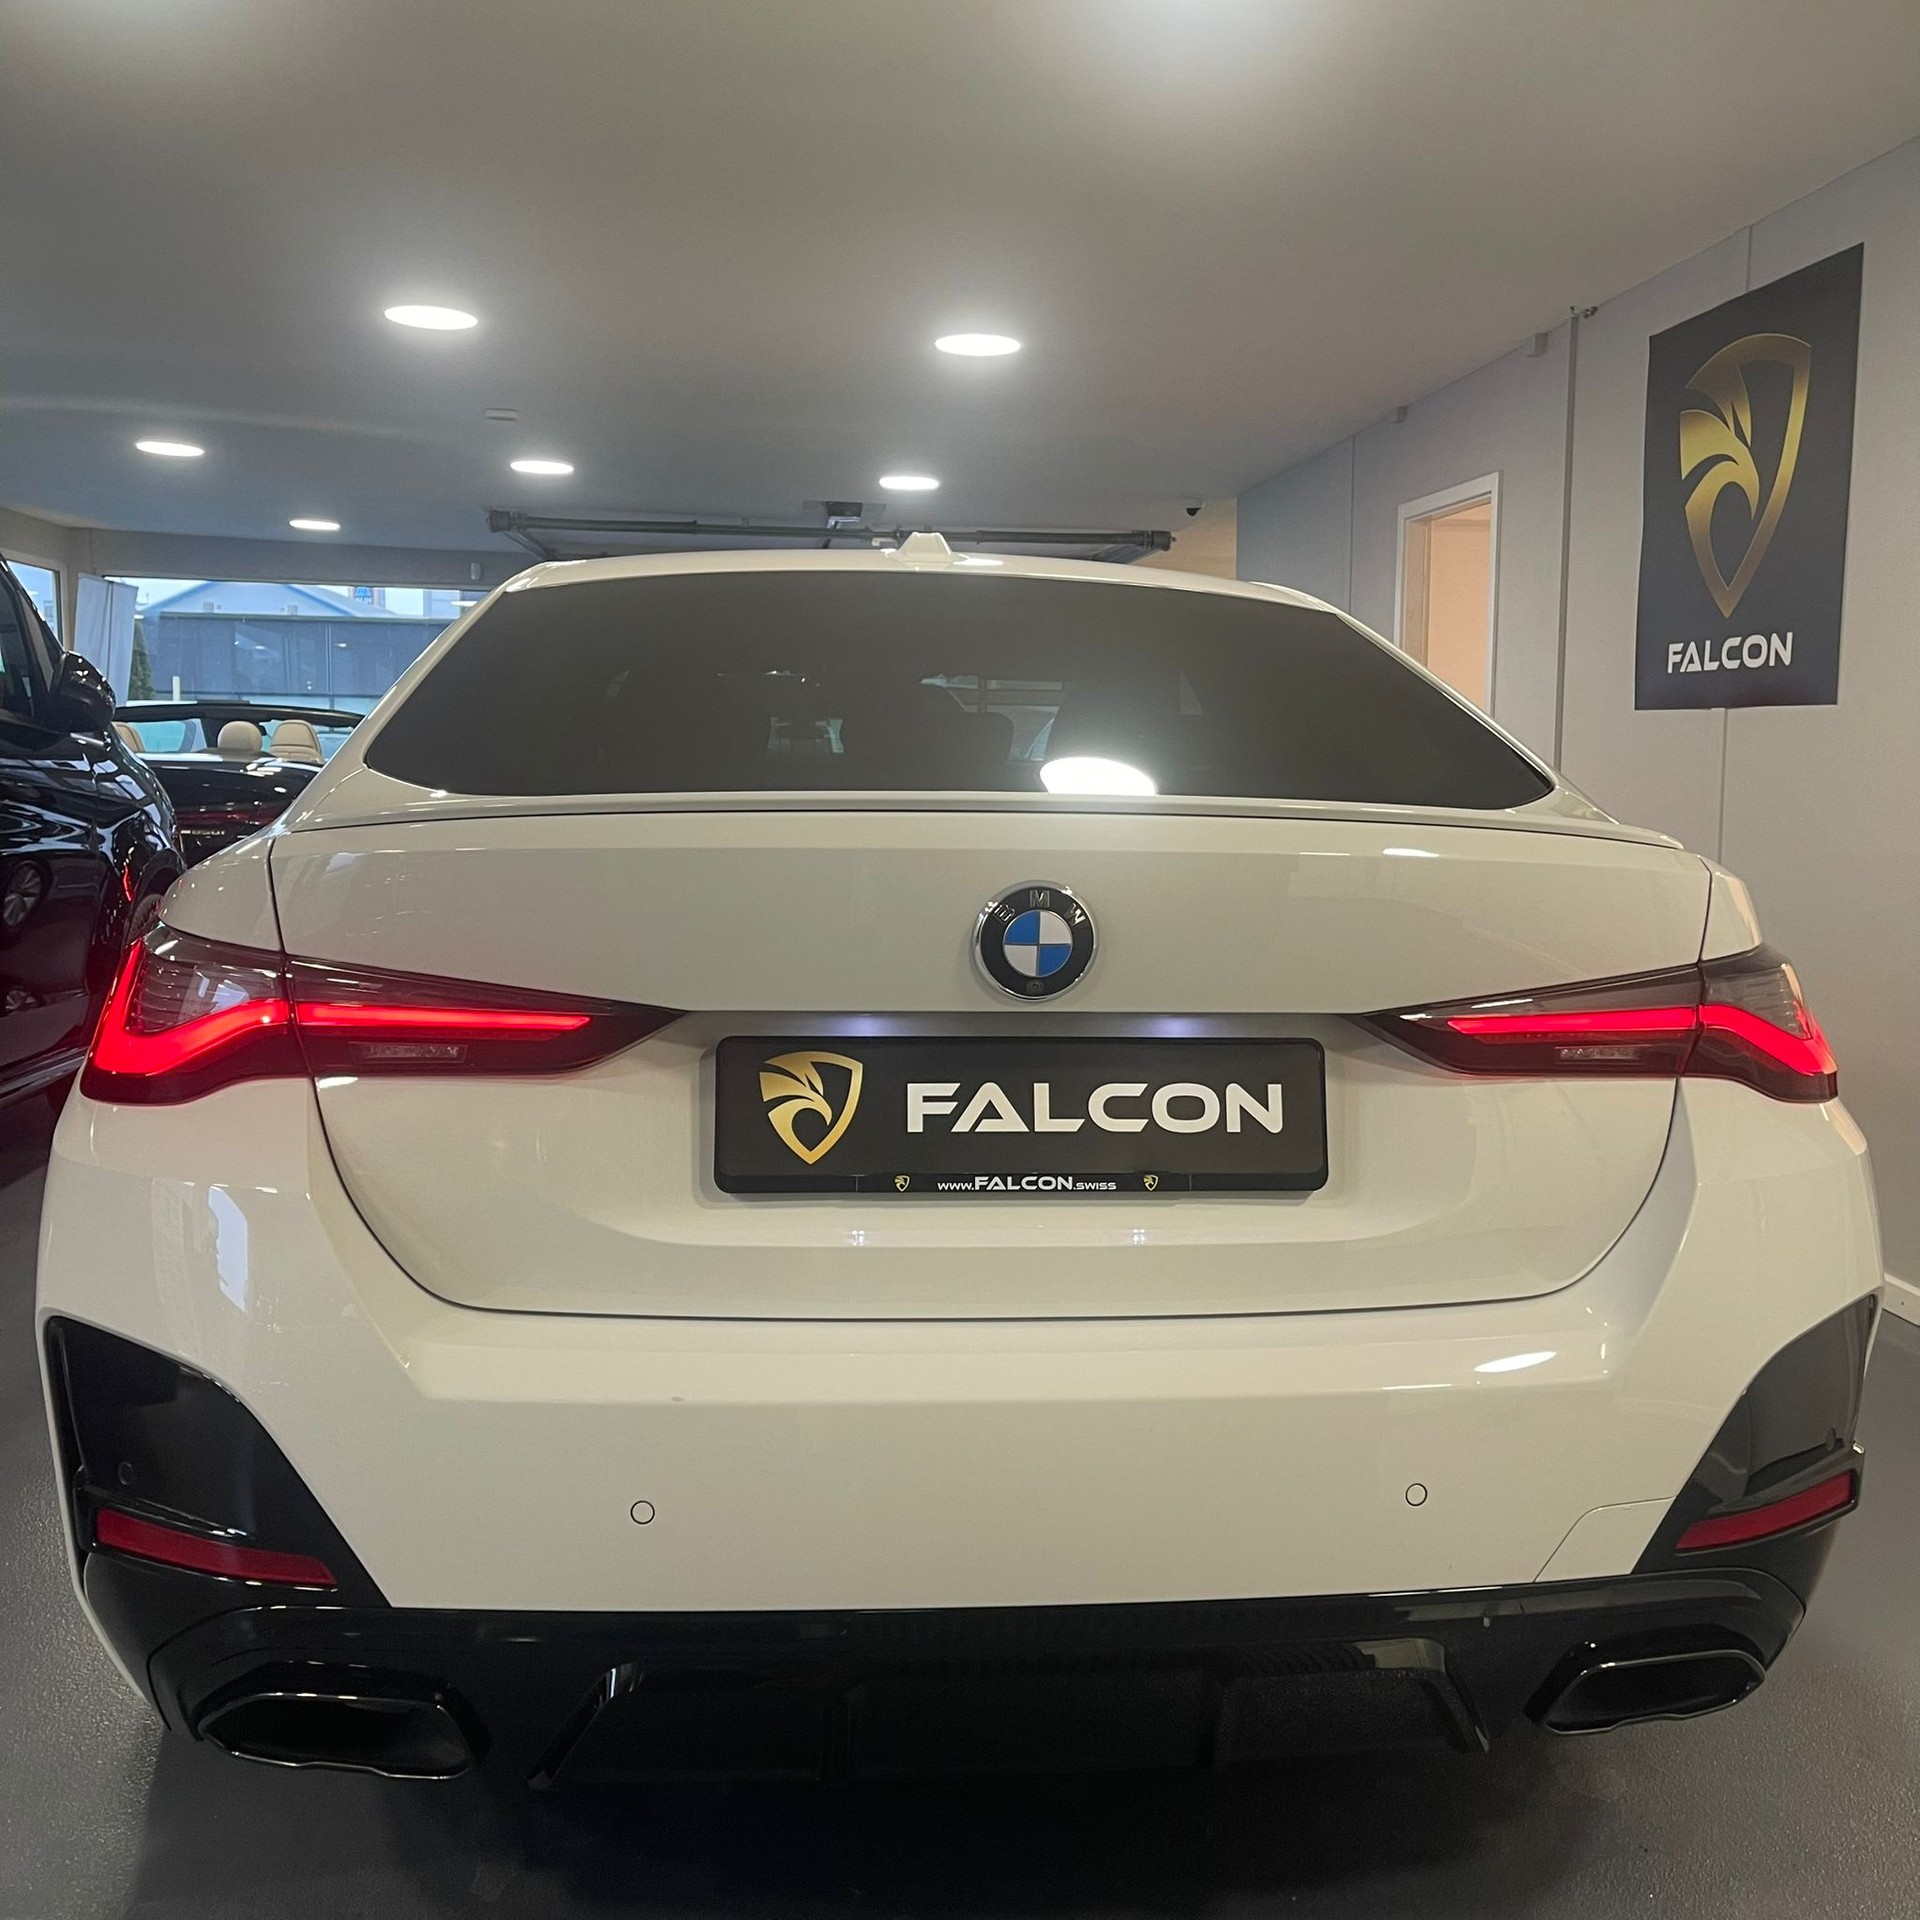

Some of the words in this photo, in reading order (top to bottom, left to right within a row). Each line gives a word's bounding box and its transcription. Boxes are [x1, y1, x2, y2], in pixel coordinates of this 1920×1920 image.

[1667, 631, 1793, 674] FALCON
[992, 889, 1086, 927] BMW
[906, 1081, 1283, 1134] FALCON
